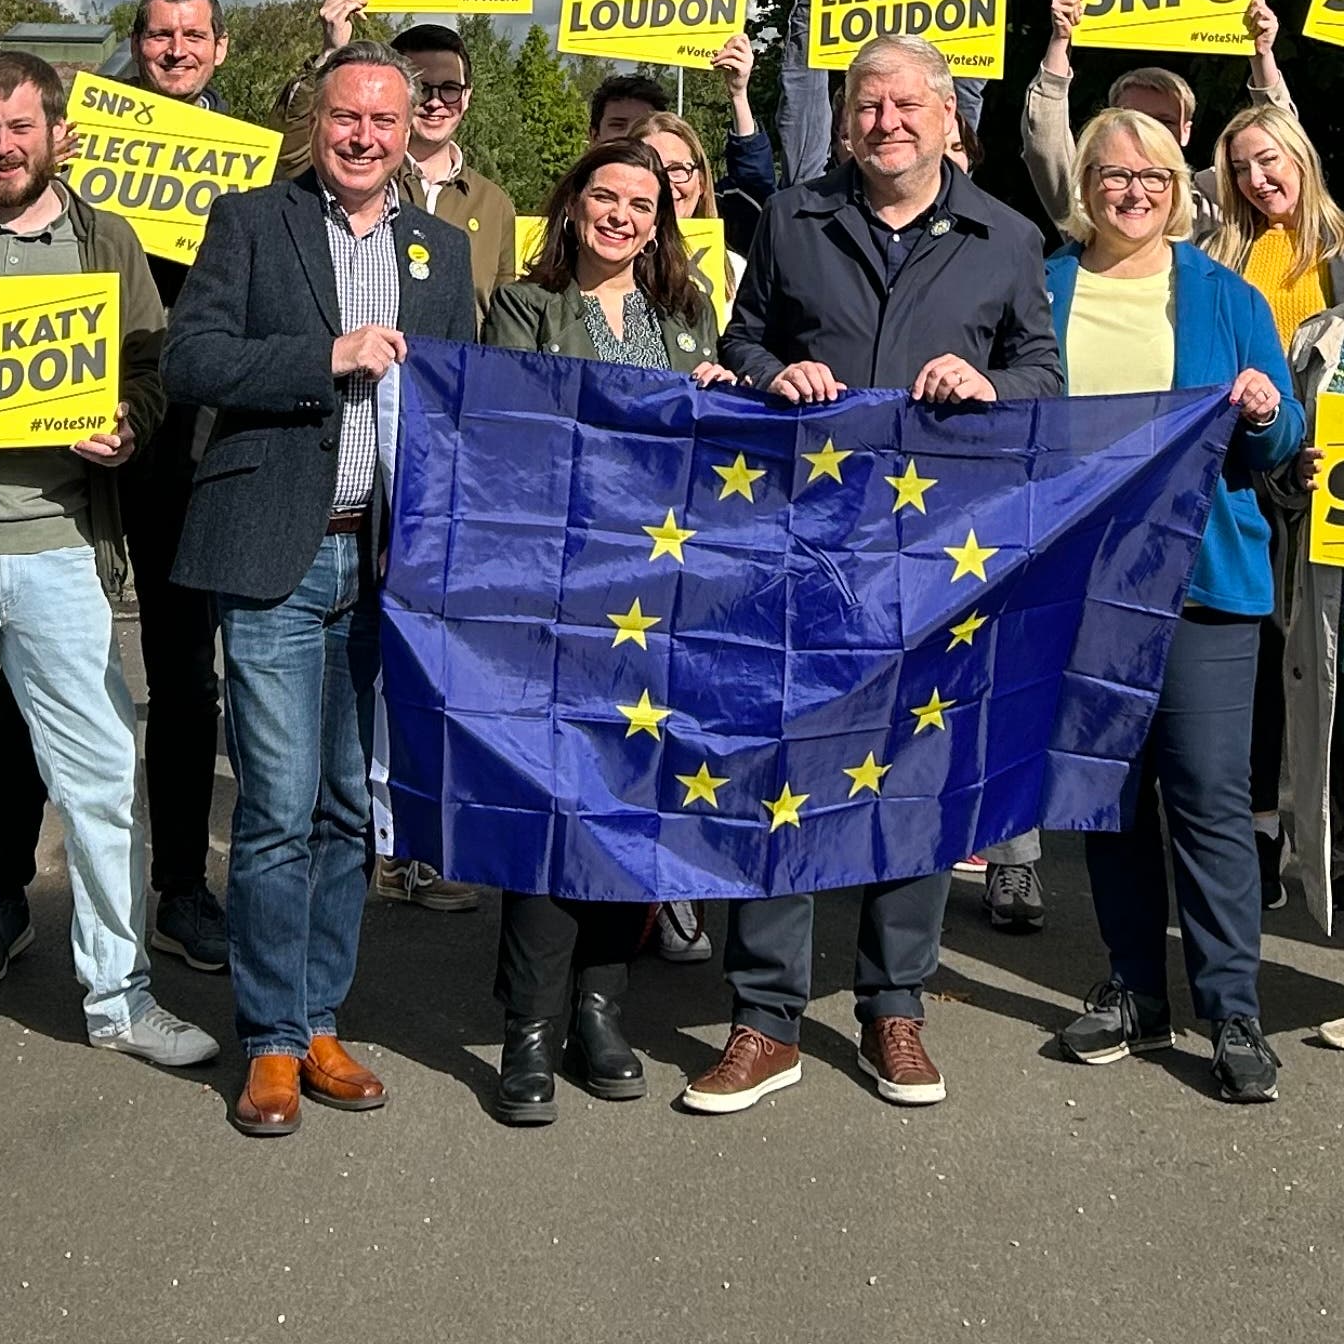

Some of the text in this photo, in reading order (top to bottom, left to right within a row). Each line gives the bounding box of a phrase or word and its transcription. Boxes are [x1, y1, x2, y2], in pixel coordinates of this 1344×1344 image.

[945, 53, 995, 67] VoteSNP
[81, 86, 135, 118] SNP
[170, 145, 267, 181] KATY
[2, 302, 107, 352] KATY
[30, 416, 107, 432] #VoteSNP
